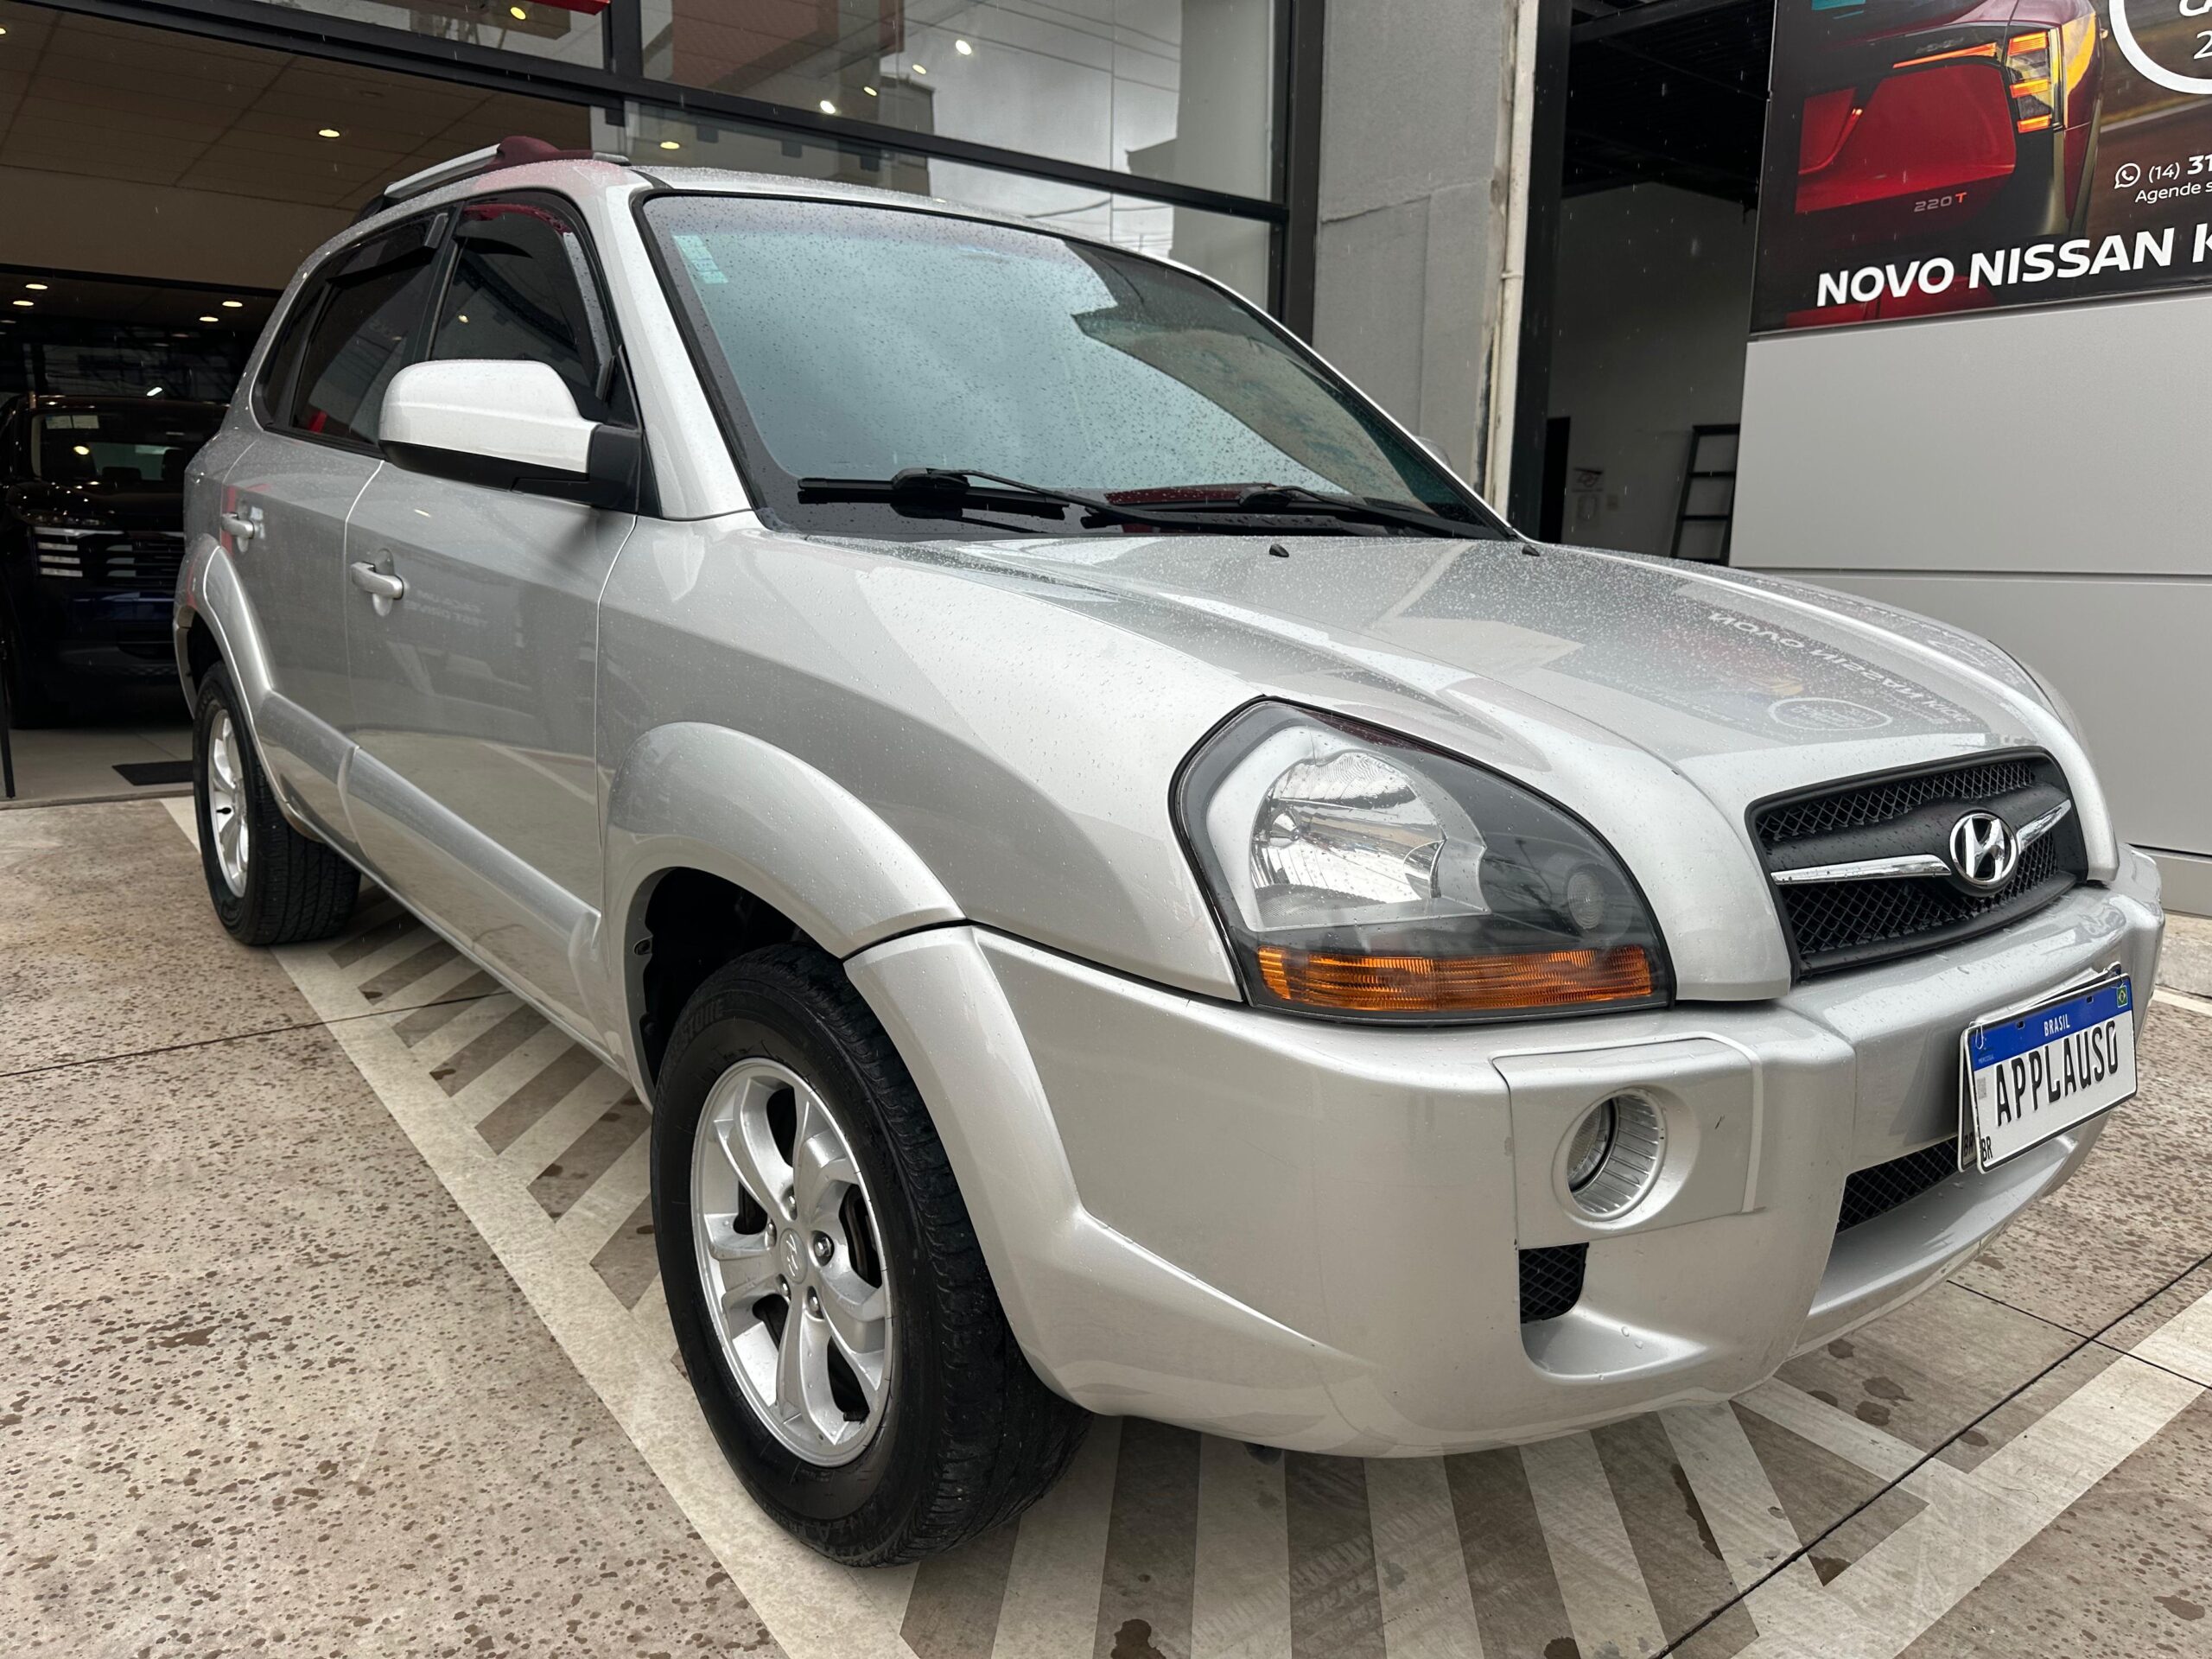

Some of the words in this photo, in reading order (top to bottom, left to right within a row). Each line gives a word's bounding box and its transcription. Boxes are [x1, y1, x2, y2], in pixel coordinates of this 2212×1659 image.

[2148, 162, 2181, 184] (14)
[1913, 191, 1968, 213] 220T
[2134, 181, 2202, 205] Agende
[1815, 257, 1955, 308] NOVO
[1968, 226, 2176, 289] NISSAN
[2043, 1013, 2071, 1038] BRASIL
[1994, 1019, 2119, 1128] APPLAUSO
[1980, 1135, 1993, 1162] BR
